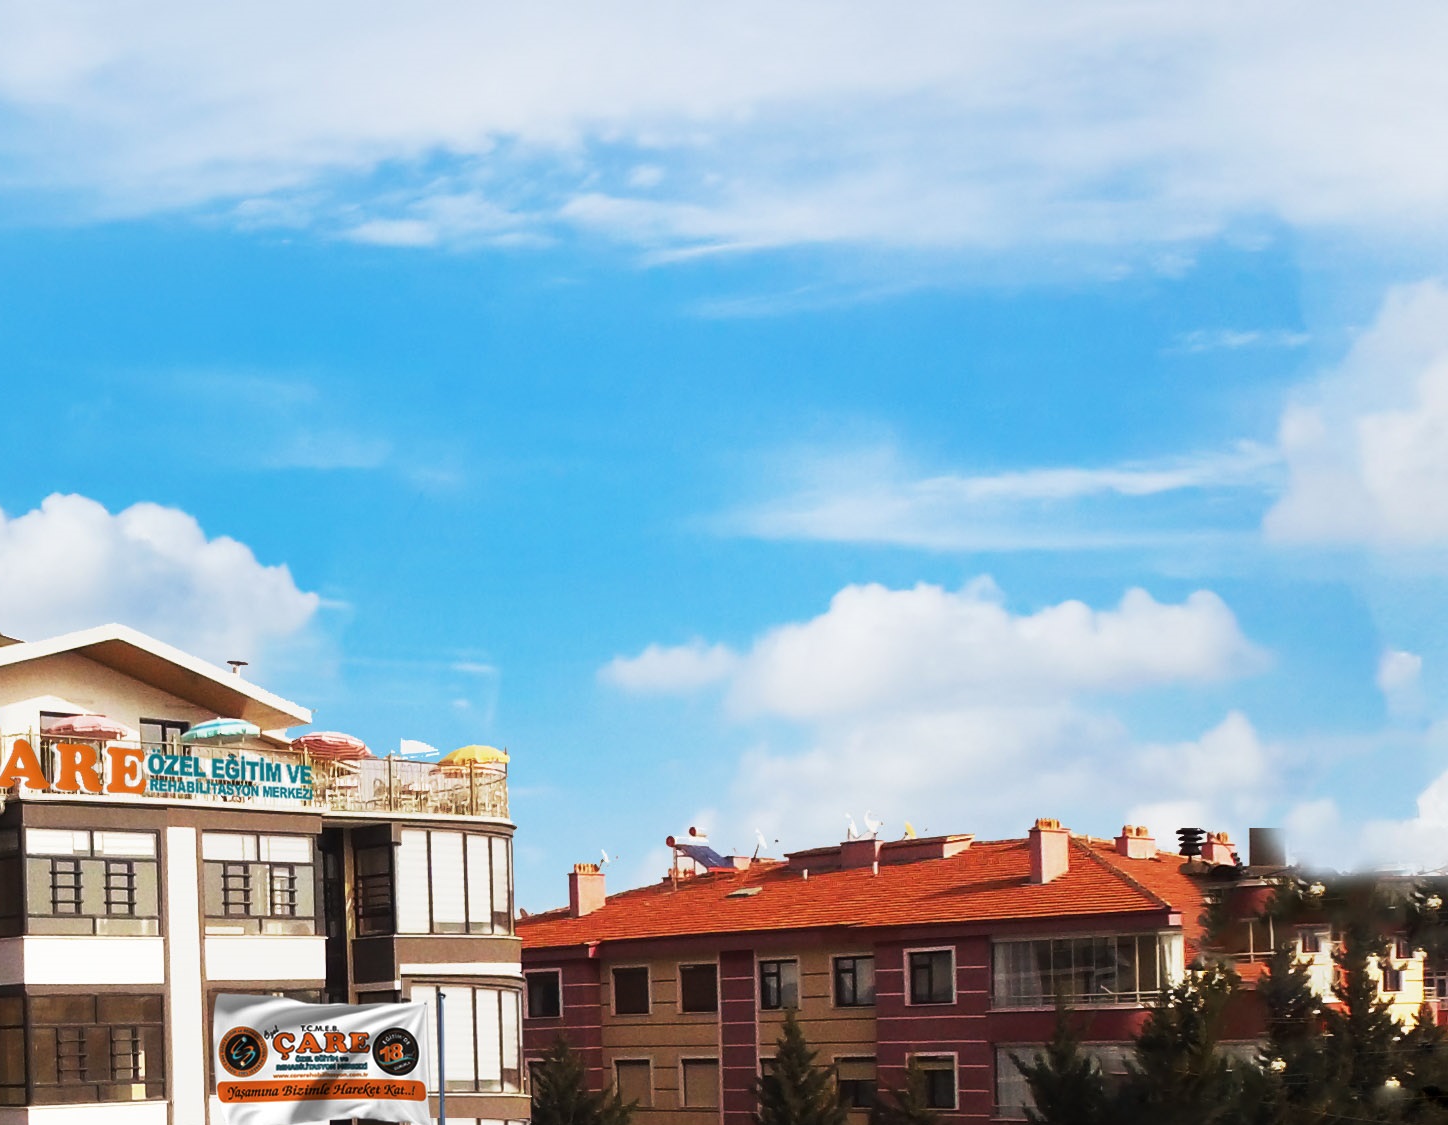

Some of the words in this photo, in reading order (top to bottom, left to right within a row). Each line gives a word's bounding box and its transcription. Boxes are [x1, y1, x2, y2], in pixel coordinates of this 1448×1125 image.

[148, 749, 206, 777] ÖZEL
[212, 753, 282, 783] EĞİTİM
[286, 764, 312, 784] VE
[150, 778, 259, 797] REHABİLİTASYON
[263, 785, 313, 800] MERKEZİ
[273, 1032, 370, 1060] ÇARE
[379, 1043, 403, 1062] 18
[227, 1086, 279, 1100] Yaşamına
[282, 1083, 330, 1096] Bizimle
[333, 1082, 380, 1097] Hareket
